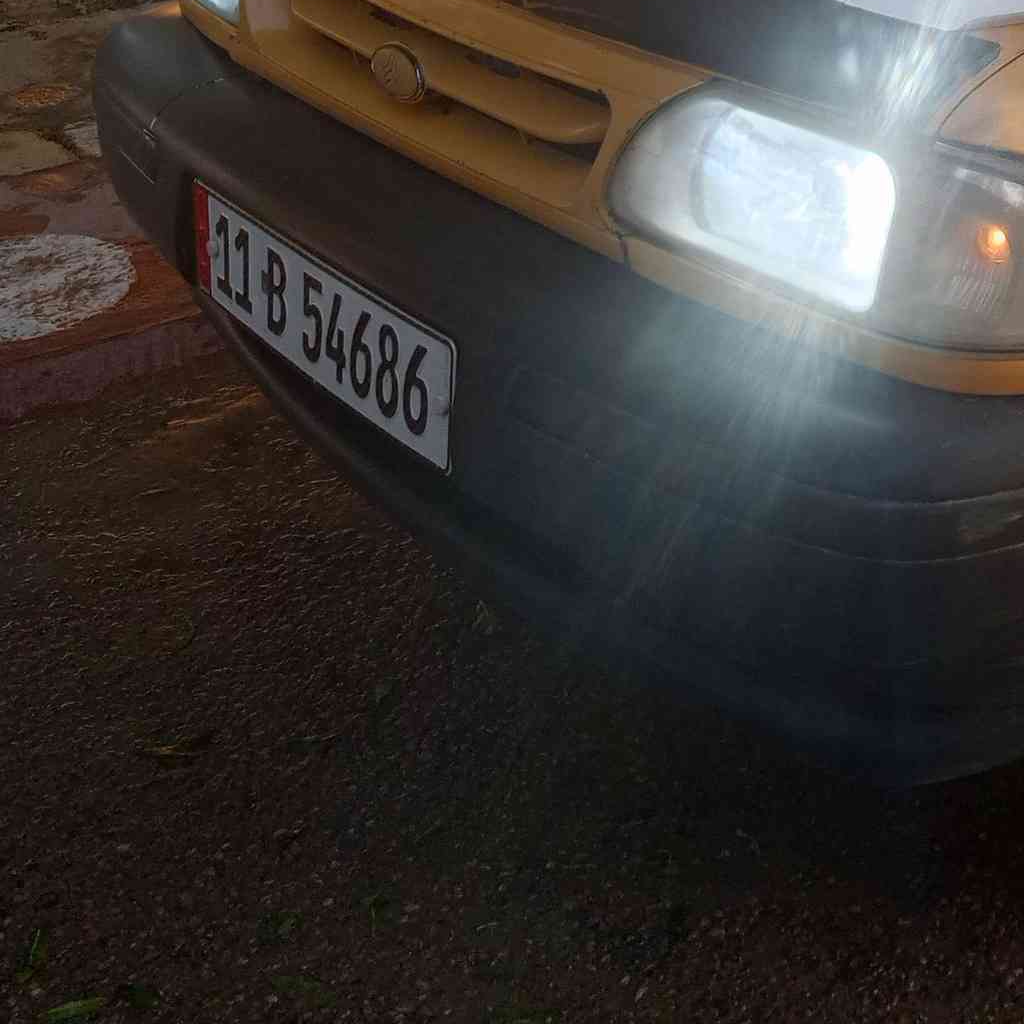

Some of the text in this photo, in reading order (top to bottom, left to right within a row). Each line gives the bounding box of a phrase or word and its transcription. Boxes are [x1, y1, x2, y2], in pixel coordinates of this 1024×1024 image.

[215, 214, 429, 436] 11 B 54686
